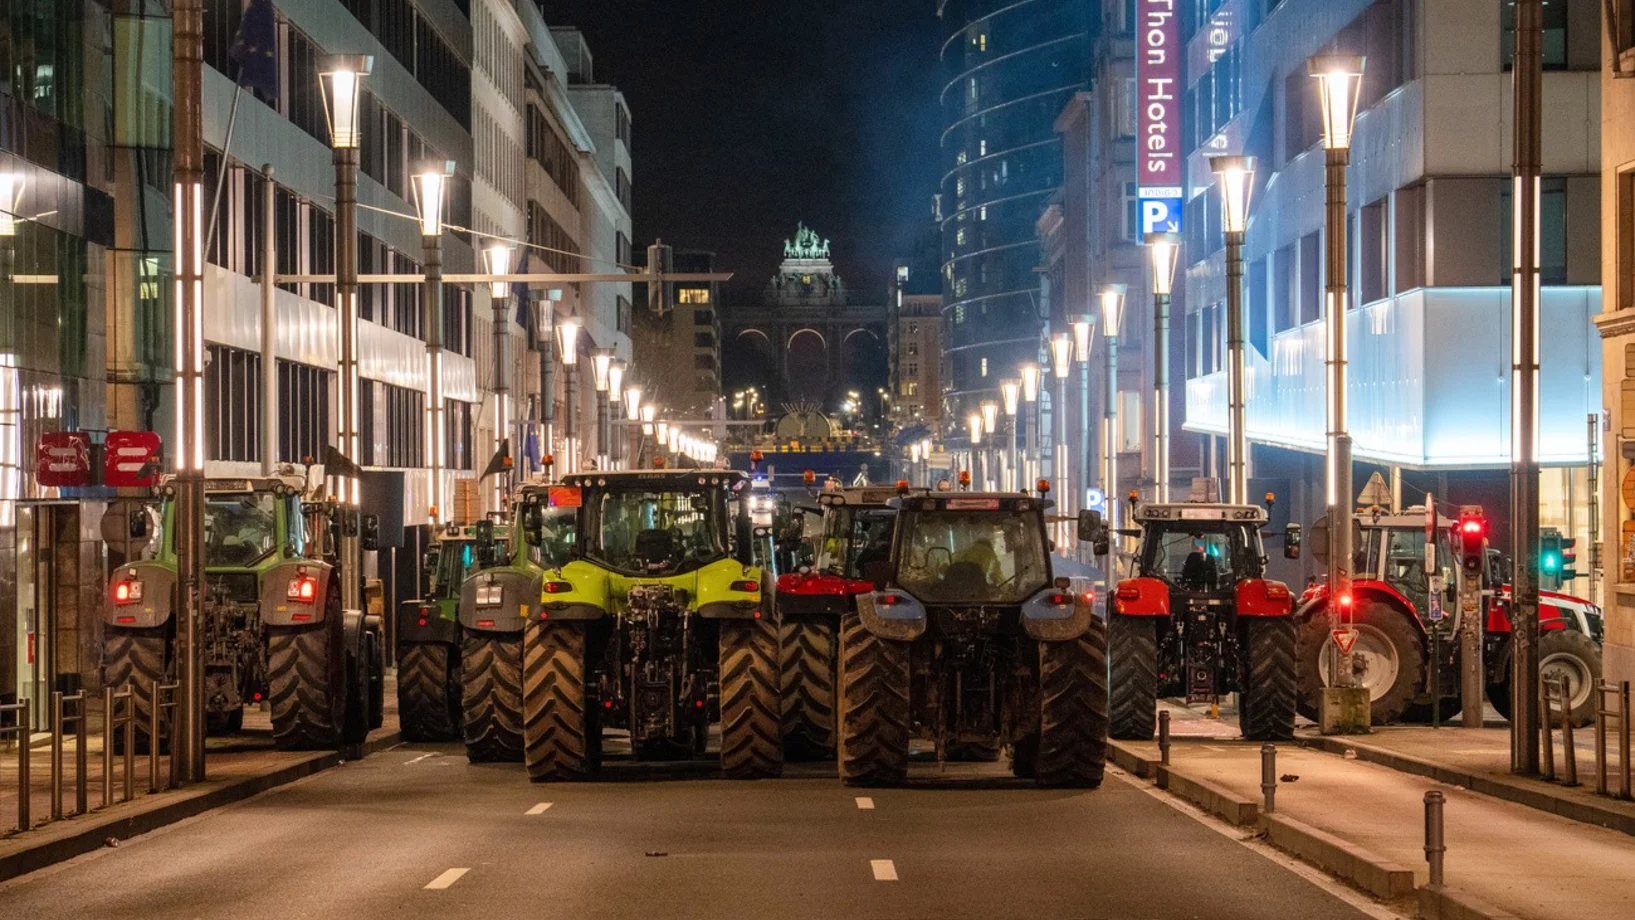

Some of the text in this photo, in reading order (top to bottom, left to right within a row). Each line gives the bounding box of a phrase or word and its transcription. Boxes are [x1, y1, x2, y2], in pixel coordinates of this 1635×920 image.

[1147, 0, 1173, 173] Thon Hotels
[1143, 201, 1168, 233] P
[1087, 488, 1101, 510] P
